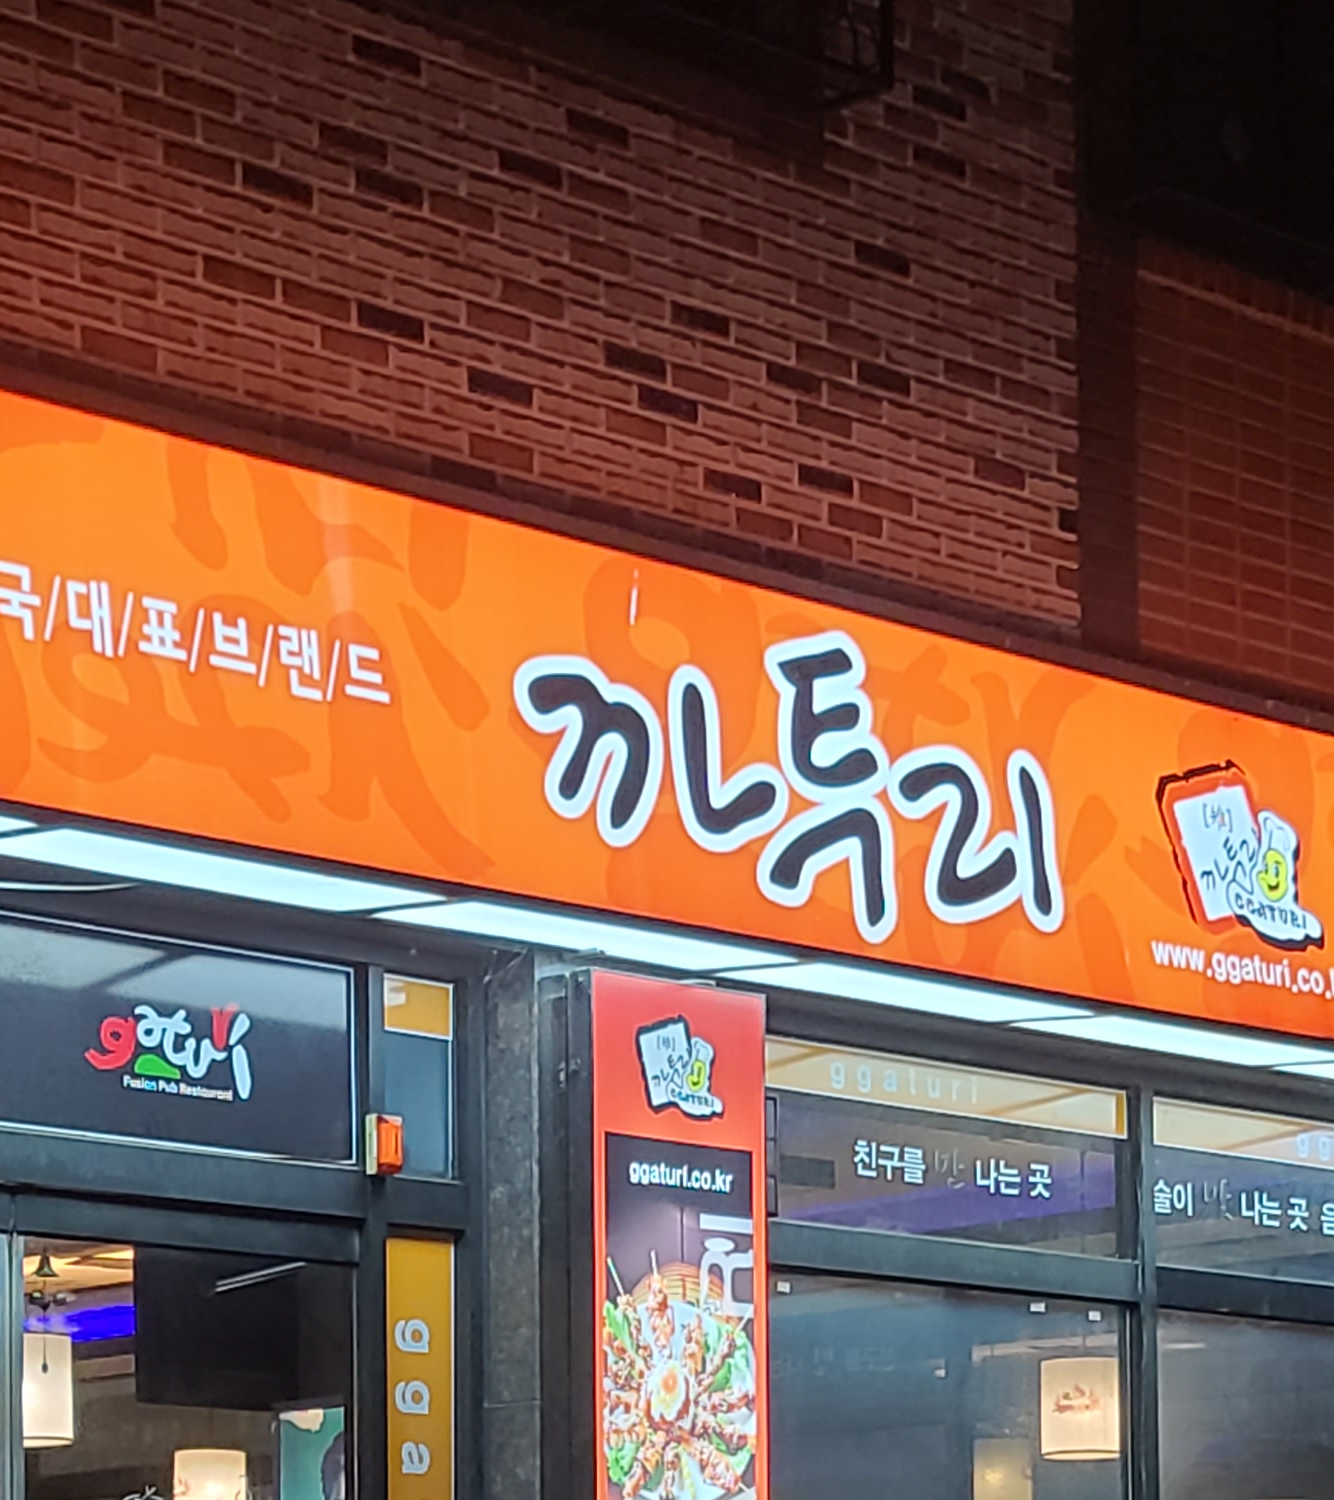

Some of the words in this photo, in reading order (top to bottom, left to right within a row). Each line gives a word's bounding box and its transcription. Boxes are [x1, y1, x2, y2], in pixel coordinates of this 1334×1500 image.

[517, 635, 1061, 938] 까투리
[830, 1060, 978, 1104] ggaturi
[629, 1159, 734, 1194] ggaturi.co.kr
[853, 1138, 927, 1185] 친구를
[975, 1157, 1023, 1196] 나는
[1028, 1161, 1053, 1199] 곳
[1153, 1178, 1194, 1217] 술이
[1240, 1189, 1282, 1228] 나는
[1287, 1196, 1310, 1231] 곳
